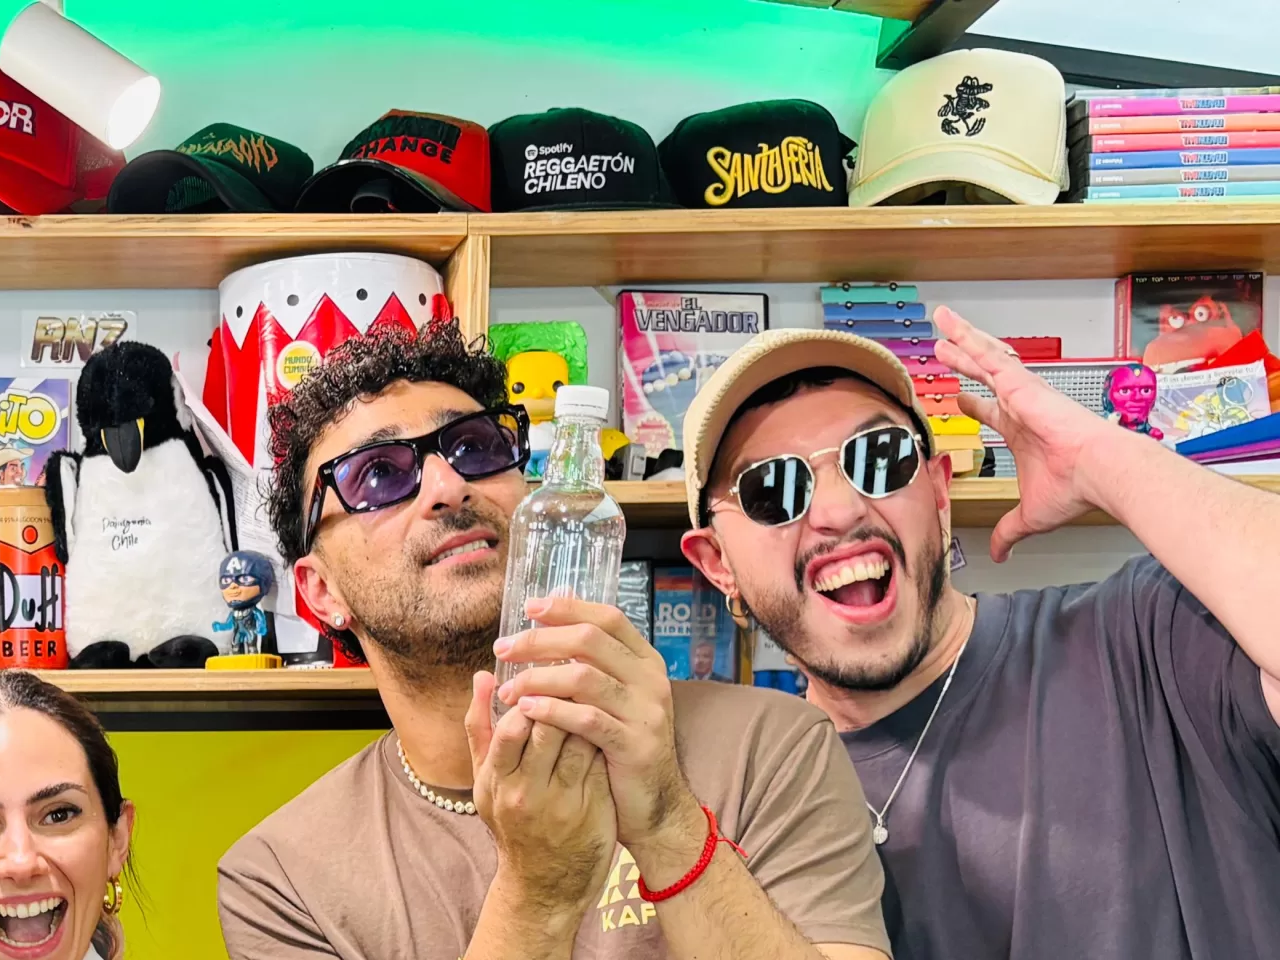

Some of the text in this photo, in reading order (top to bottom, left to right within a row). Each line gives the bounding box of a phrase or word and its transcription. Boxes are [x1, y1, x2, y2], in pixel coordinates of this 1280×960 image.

[539, 142, 573, 157] Spotify
[524, 152, 635, 179] REGGAETÓN
[524, 172, 606, 195] CHILENO
[681, 297, 702, 310] EL
[634, 309, 759, 333] VENGADOR
[112, 533, 138, 551] Chile
[654, 602, 716, 622] ROLD
[2, 640, 57, 657] BEER
